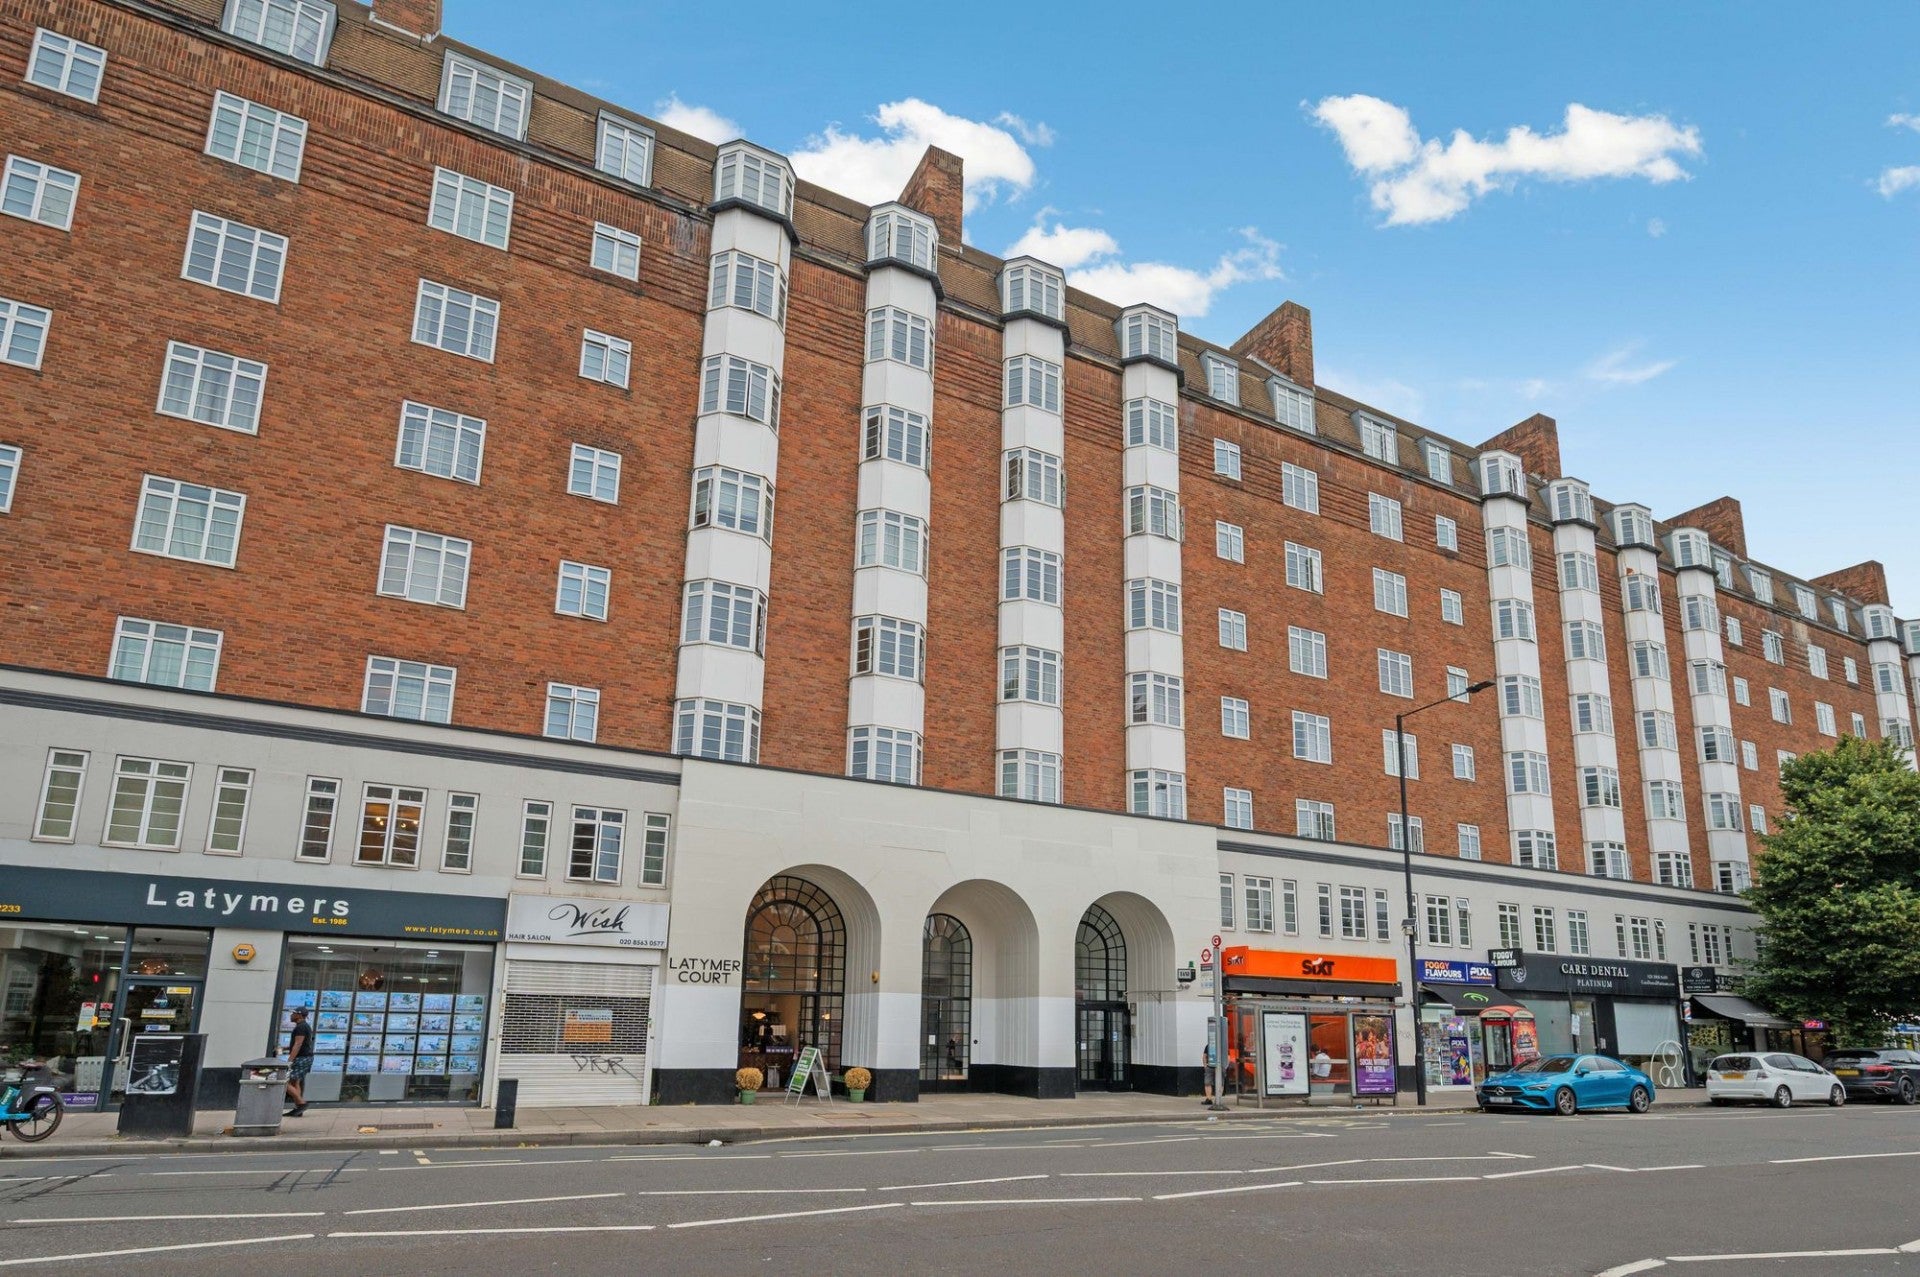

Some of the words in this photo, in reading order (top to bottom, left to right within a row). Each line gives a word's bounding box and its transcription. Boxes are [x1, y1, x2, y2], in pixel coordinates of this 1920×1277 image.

[146, 883, 350, 916] Latymers
[0, 904, 21, 913] 233
[312, 916, 327, 925] Est.
[329, 917, 348, 926] 1986
[548, 903, 631, 932] Wish
[404, 925, 499, 937] www.latymers.co.uk
[508, 933, 526, 941] HAIR
[527, 934, 551, 942] SALON
[1492, 951, 1513, 960] FOGGY
[669, 957, 741, 972] LATYMER
[1424, 961, 1450, 970] FOGGY
[1425, 969, 1462, 979] FLAVOURS
[1469, 967, 1492, 977] PIXL
[1561, 963, 1588, 976] CARE
[1591, 965, 1629, 978] DENTAL
[678, 971, 731, 984] COURT
[1577, 979, 1613, 988] PLATINUM
